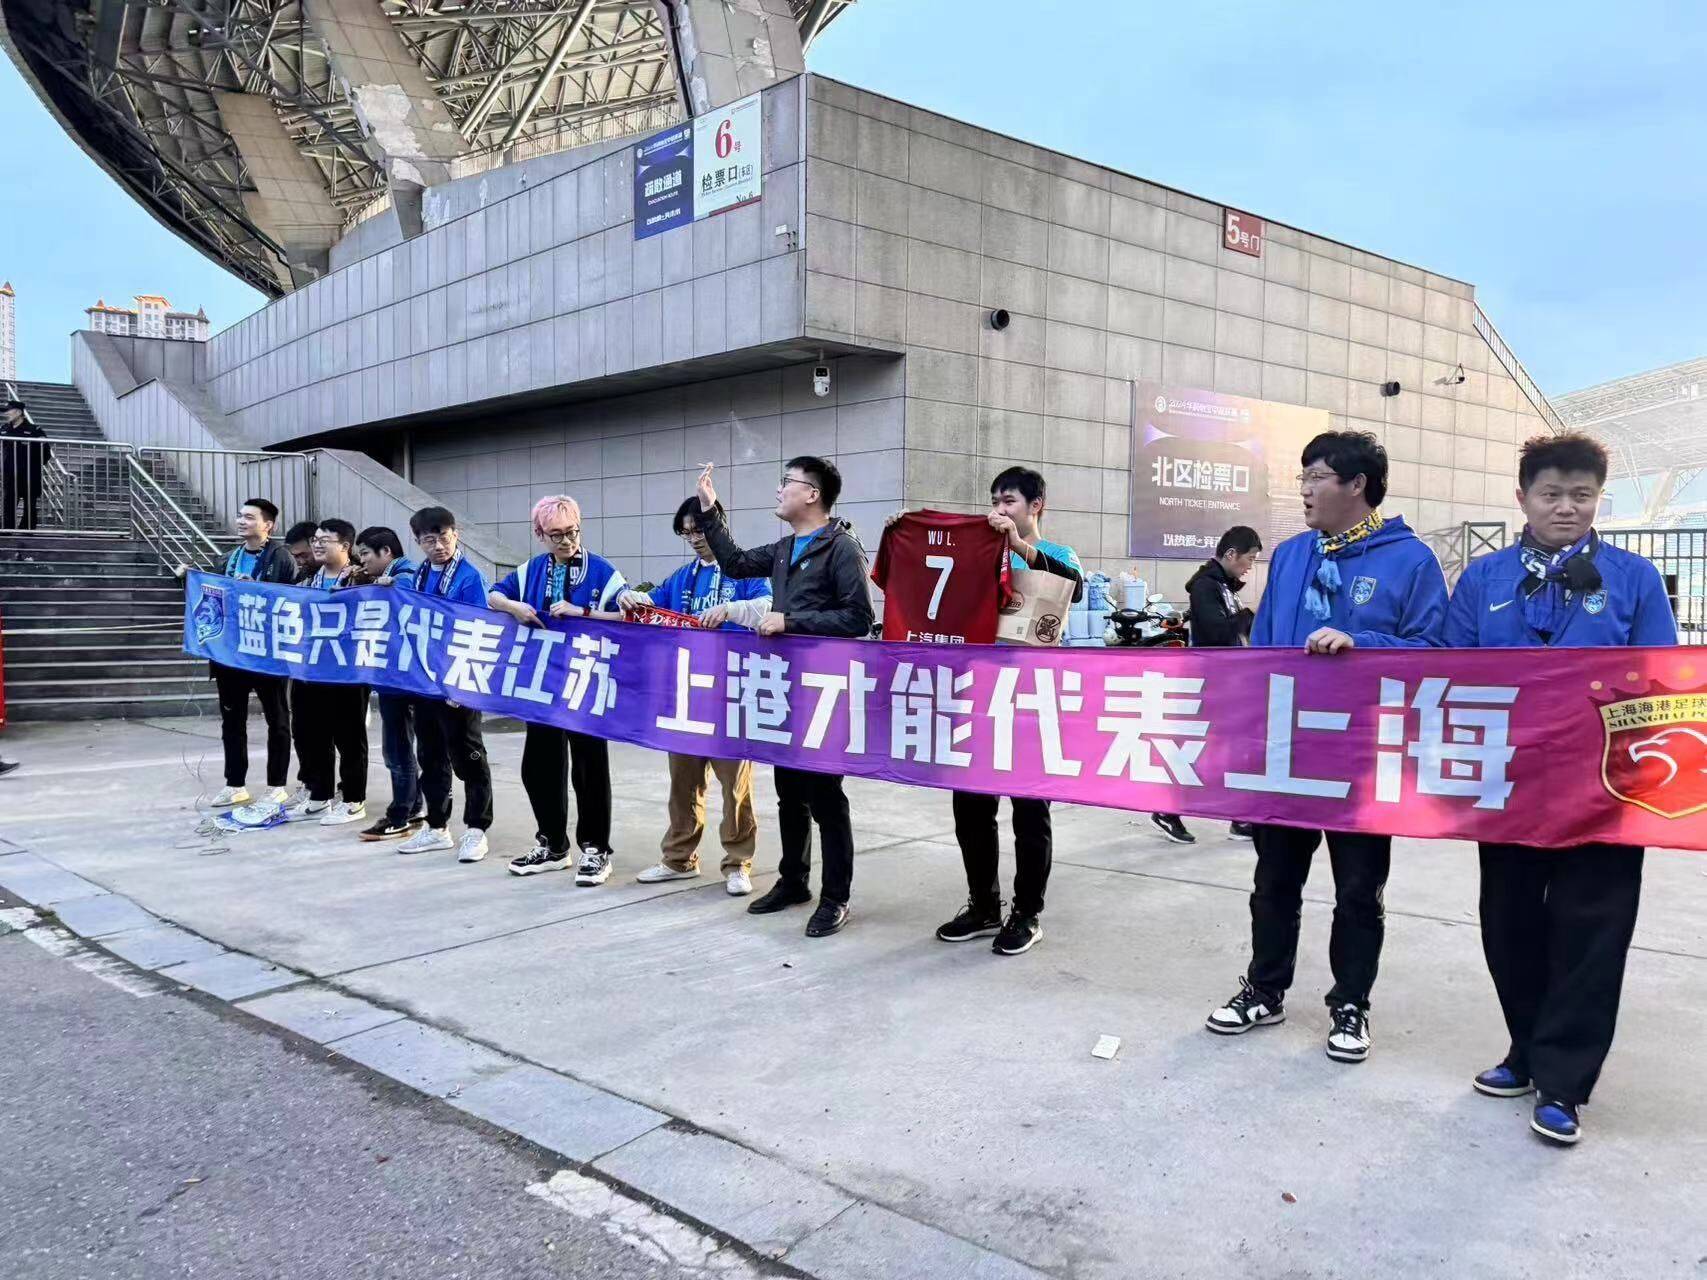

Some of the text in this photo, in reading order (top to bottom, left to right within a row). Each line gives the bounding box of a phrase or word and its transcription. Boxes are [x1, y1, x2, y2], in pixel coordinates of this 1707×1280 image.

[1227, 214, 1260, 251] 5号门
[1152, 456, 1249, 492] 北区检票口
[1159, 497, 1241, 511] NORTH TICKET ENTRANCE
[928, 530, 956, 546] WU L.
[925, 555, 954, 620] 7
[906, 630, 965, 643] 上汽集团
[237, 593, 1520, 812] 蓝色只是代表江苏 上港才能代表上海
[1608, 711, 1685, 729] SHANGHAI
